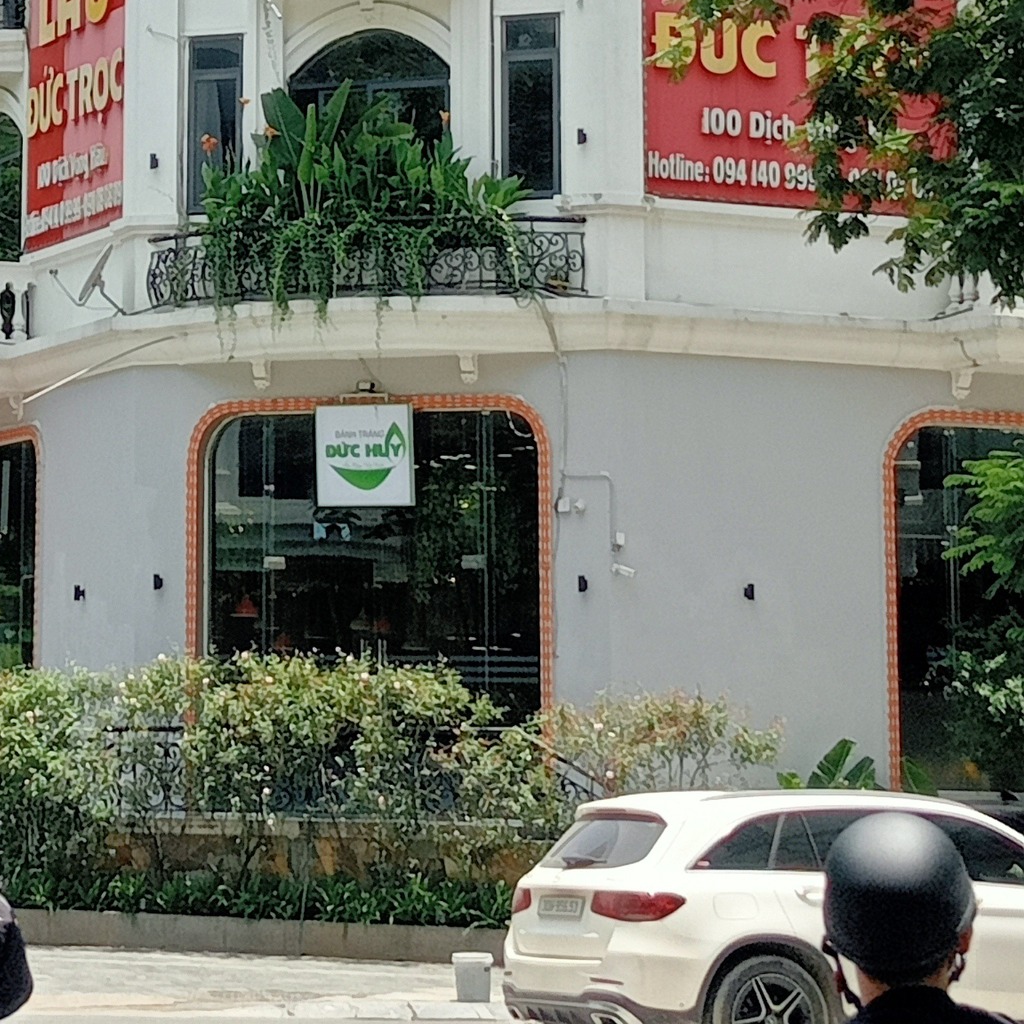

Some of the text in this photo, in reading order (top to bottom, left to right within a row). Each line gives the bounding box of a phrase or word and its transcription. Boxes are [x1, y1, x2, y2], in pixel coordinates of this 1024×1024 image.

[27, 47, 122, 138] ĐỨC TRỌC
[701, 107, 742, 138] 100
[749, 110, 795, 146] Dịch
[648, 150, 710, 183] Hotline:
[713, 156, 747, 186] 094
[751, 159, 780, 189] 140
